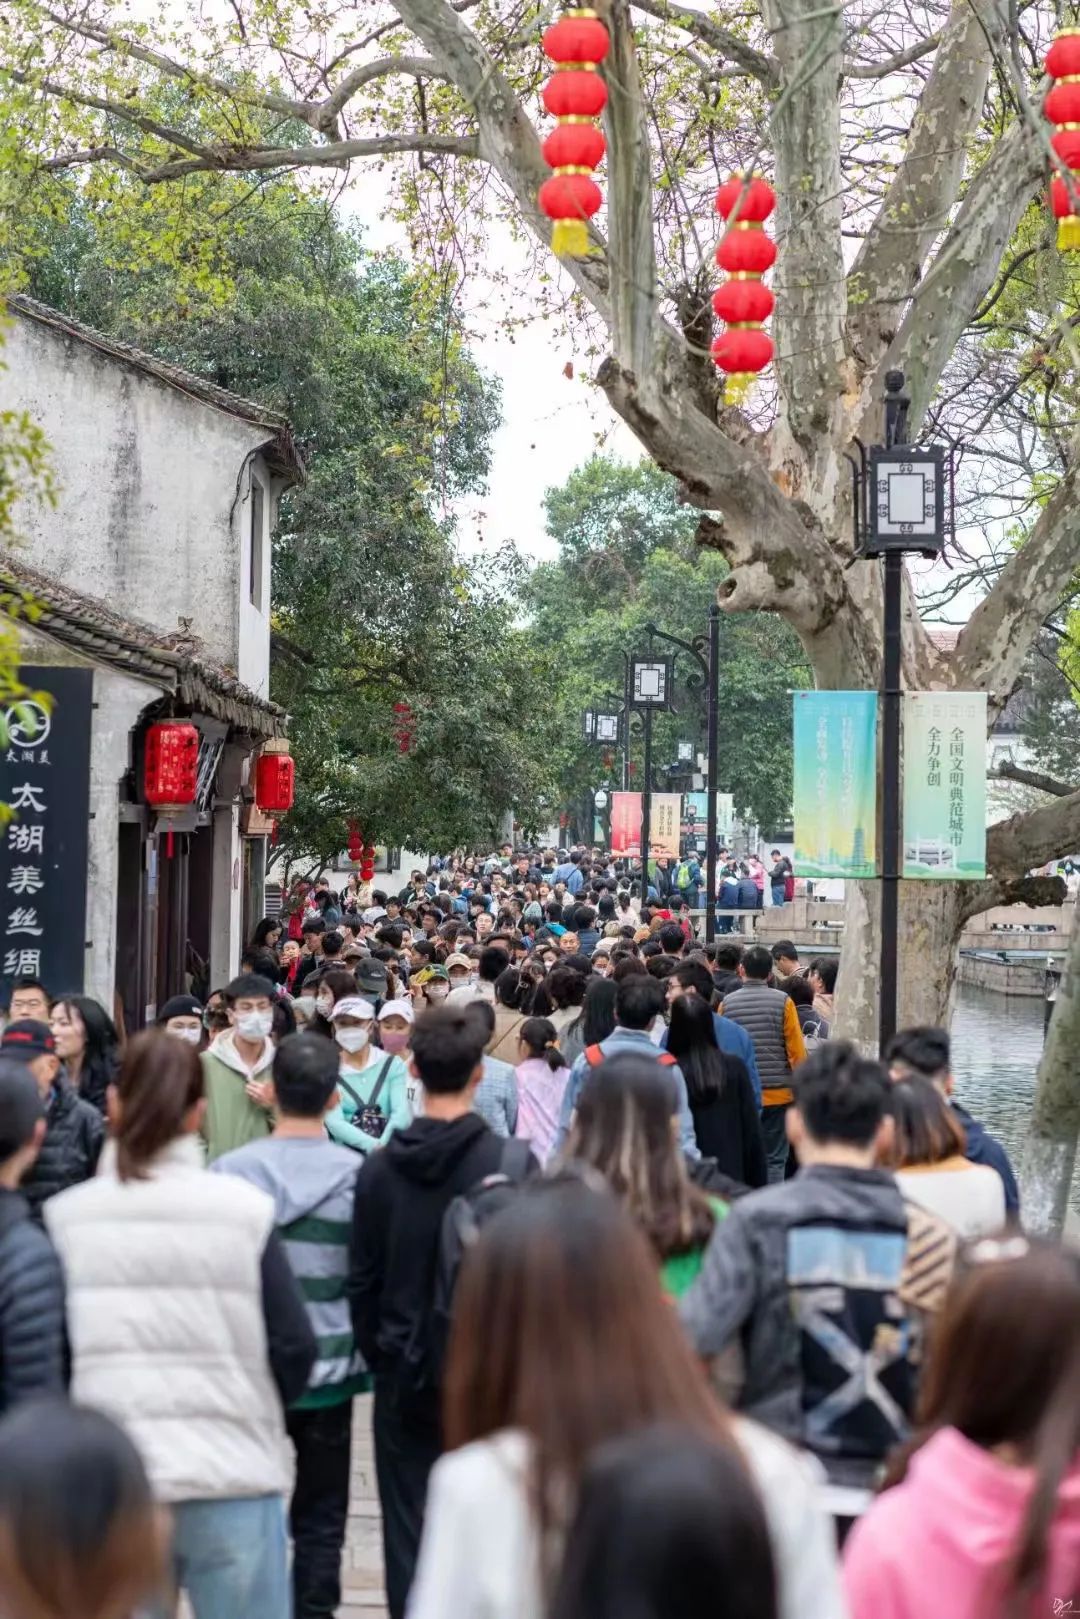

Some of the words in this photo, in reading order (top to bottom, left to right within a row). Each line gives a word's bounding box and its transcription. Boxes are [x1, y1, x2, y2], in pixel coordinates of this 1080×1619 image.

[6, 749, 52, 766] 太湖美
[927, 726, 941, 787] 全力争创
[949, 726, 964, 847] 全国文明典范城市
[3, 782, 48, 978] 太湖美丝绸
